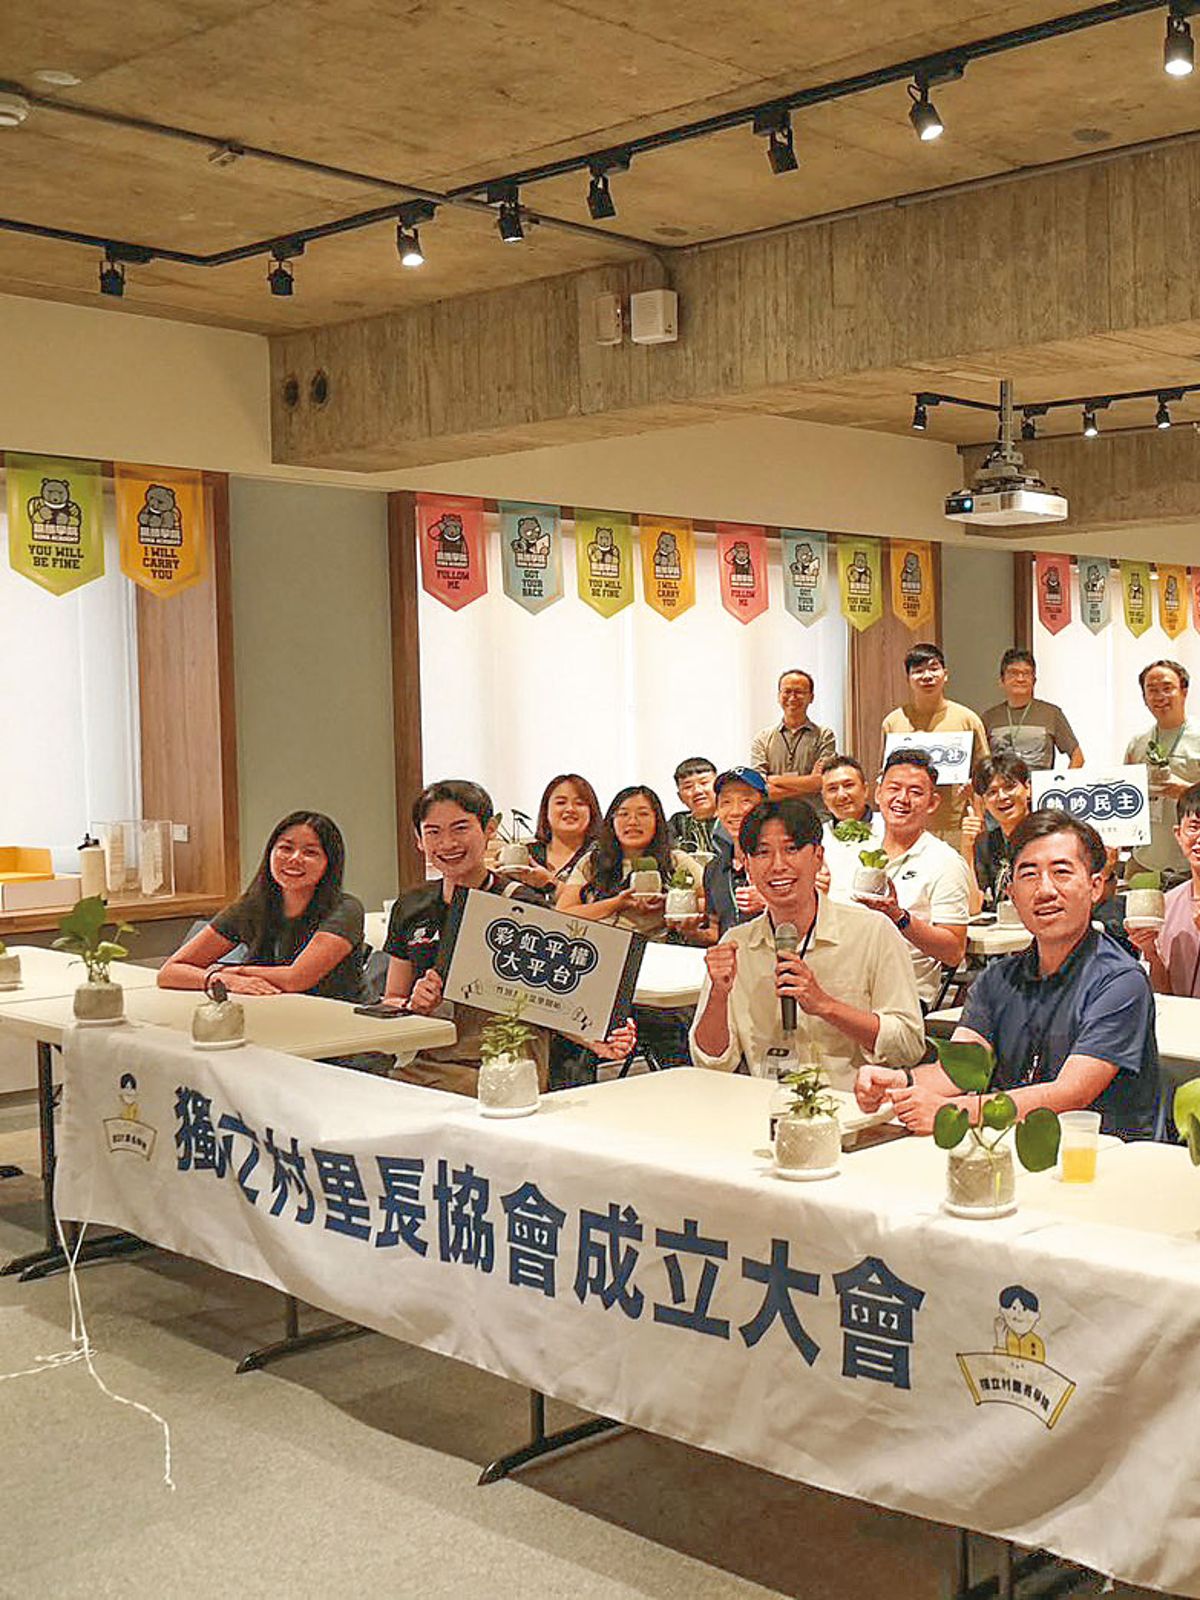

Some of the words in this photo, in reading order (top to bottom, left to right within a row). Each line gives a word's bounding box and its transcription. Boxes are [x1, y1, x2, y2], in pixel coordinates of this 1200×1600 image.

[28, 545, 51, 555] YOU
[55, 546, 84, 558] WILL
[151, 547, 178, 558] WILL
[33, 556, 49, 567] BE
[52, 558, 80, 569] FINE
[143, 558, 180, 569] CARRY
[151, 569, 173, 579] YOU
[494, 926, 590, 967] 彩虹平權
[500, 951, 571, 985] 大平台
